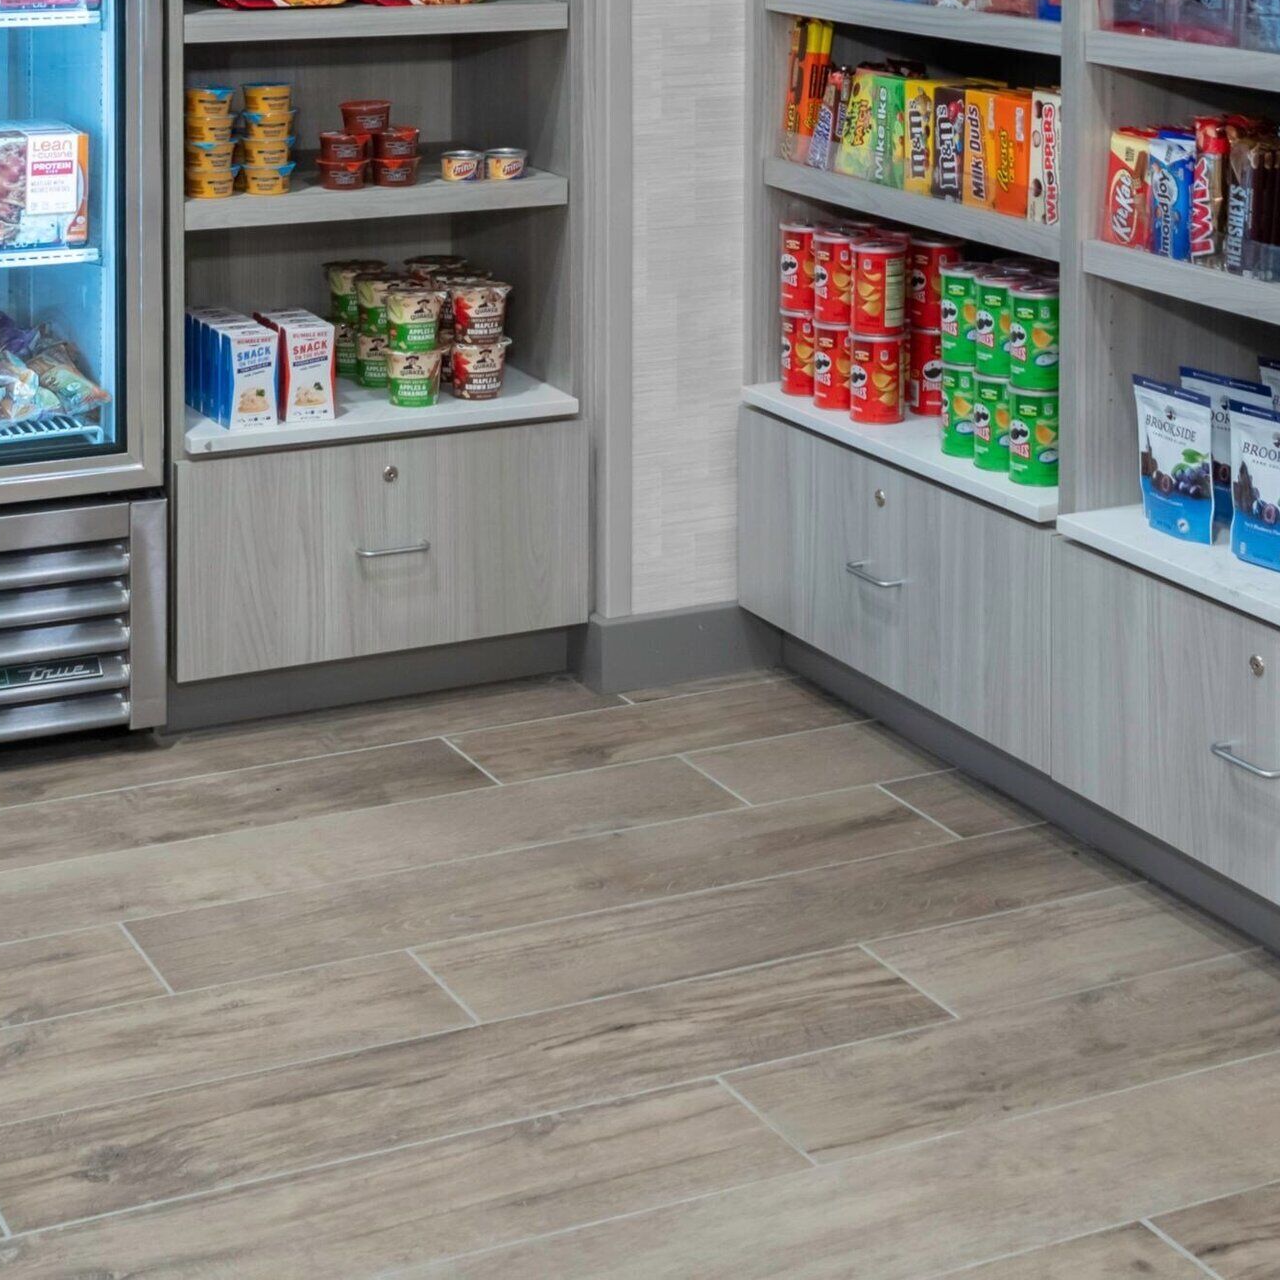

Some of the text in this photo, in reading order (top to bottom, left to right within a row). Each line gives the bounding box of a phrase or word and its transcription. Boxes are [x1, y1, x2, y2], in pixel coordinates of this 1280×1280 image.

[33, 140, 73, 152] Lean
[32, 161, 73, 170] PROTEIN
[1042, 102, 1060, 226] WHOPPERS
[1190, 157, 1215, 258] TWIX
[236, 345, 272, 362] SNACK
[293, 340, 328, 356] SNACK
[1145, 412, 1198, 443] BROOKSIDE
